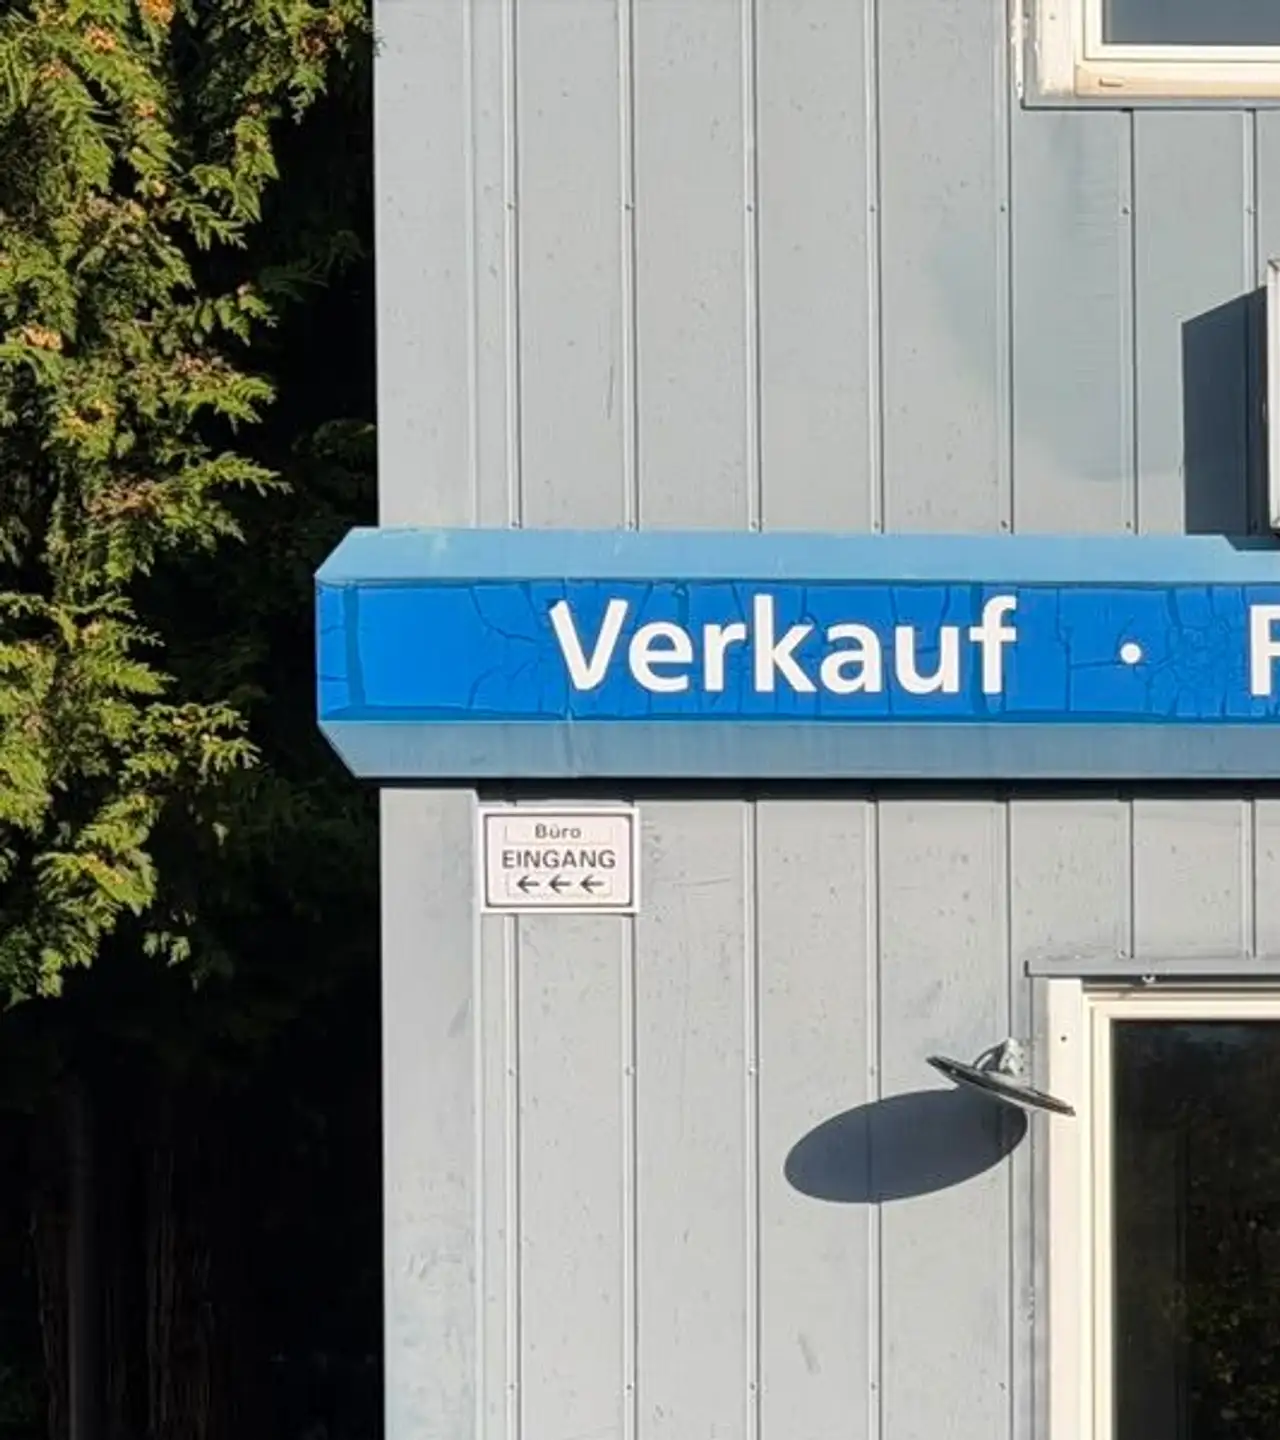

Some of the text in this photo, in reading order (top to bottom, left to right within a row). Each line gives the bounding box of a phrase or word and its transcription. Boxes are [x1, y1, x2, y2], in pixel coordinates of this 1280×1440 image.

[549, 593, 1018, 694] Verkauf
[534, 823, 582, 840] Büro
[502, 849, 616, 869] EINGANG
